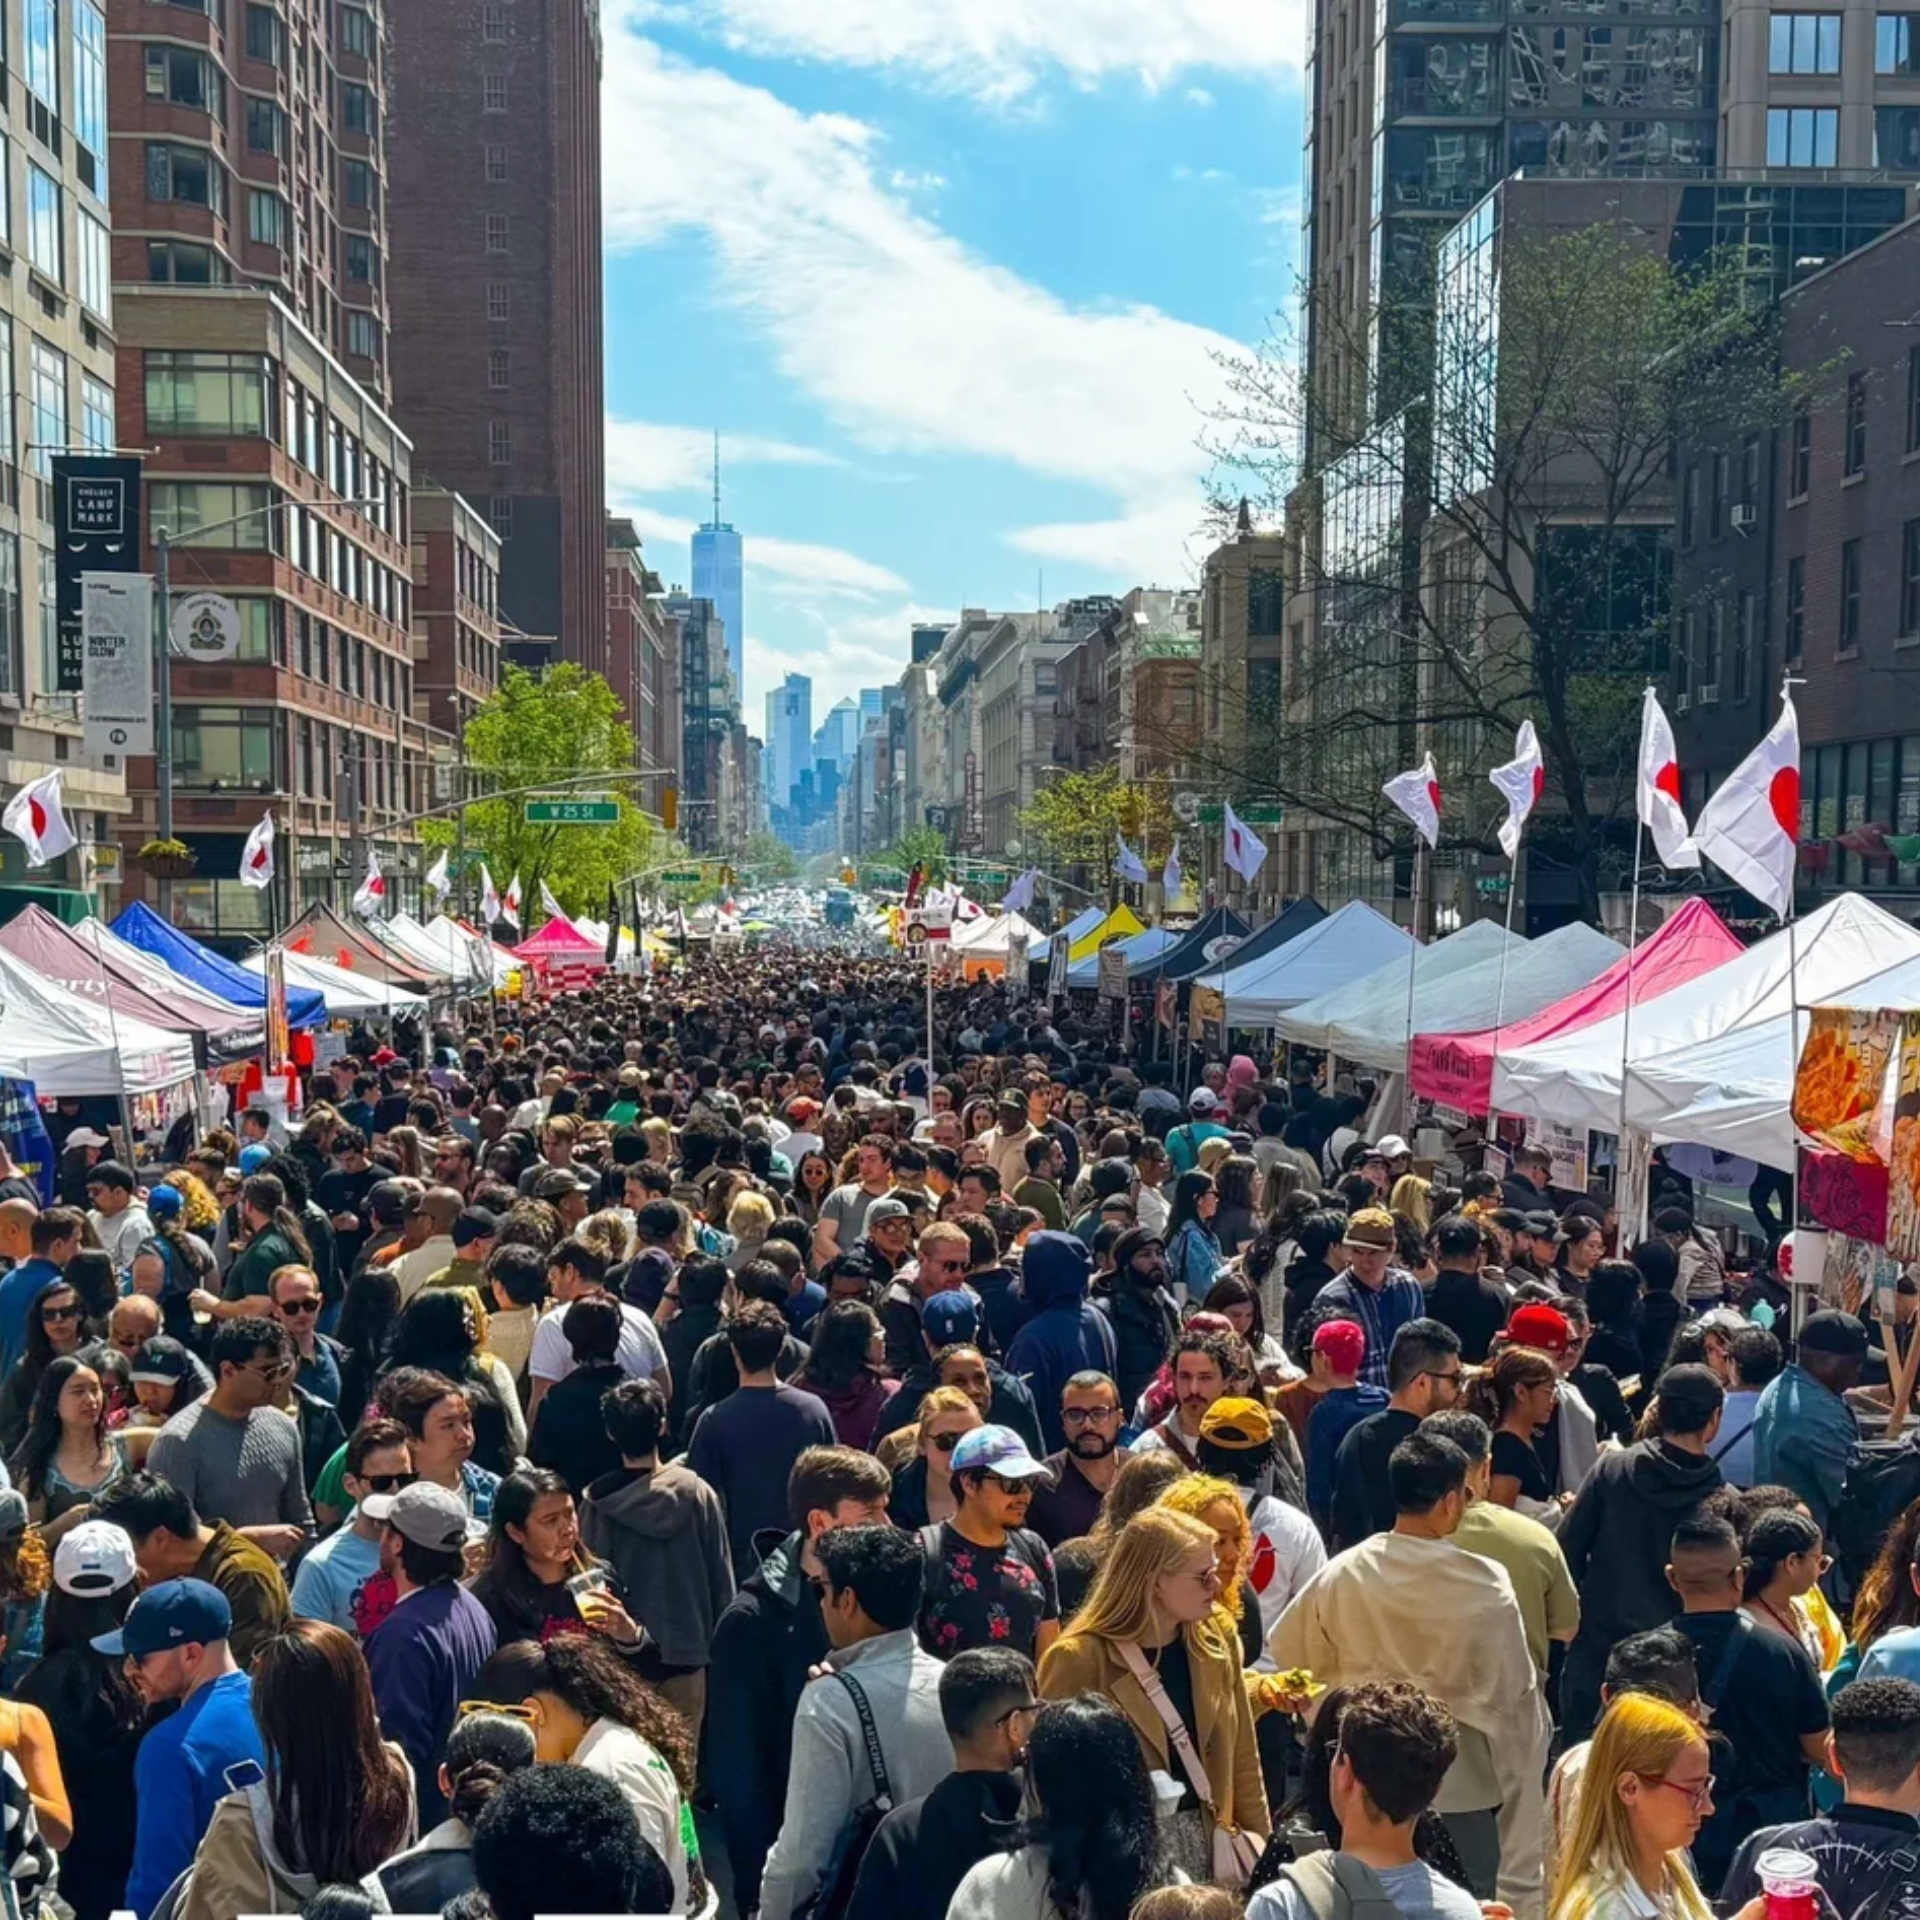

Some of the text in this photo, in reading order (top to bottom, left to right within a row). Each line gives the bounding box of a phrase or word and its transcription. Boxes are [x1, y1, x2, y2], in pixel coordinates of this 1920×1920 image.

[77, 499, 113, 510] LAND
[77, 513, 113, 523] MARK
[88, 635, 125, 648] WINTER
[550, 805, 594, 818] W 25 St
[864, 1723, 885, 1779] UNDER
